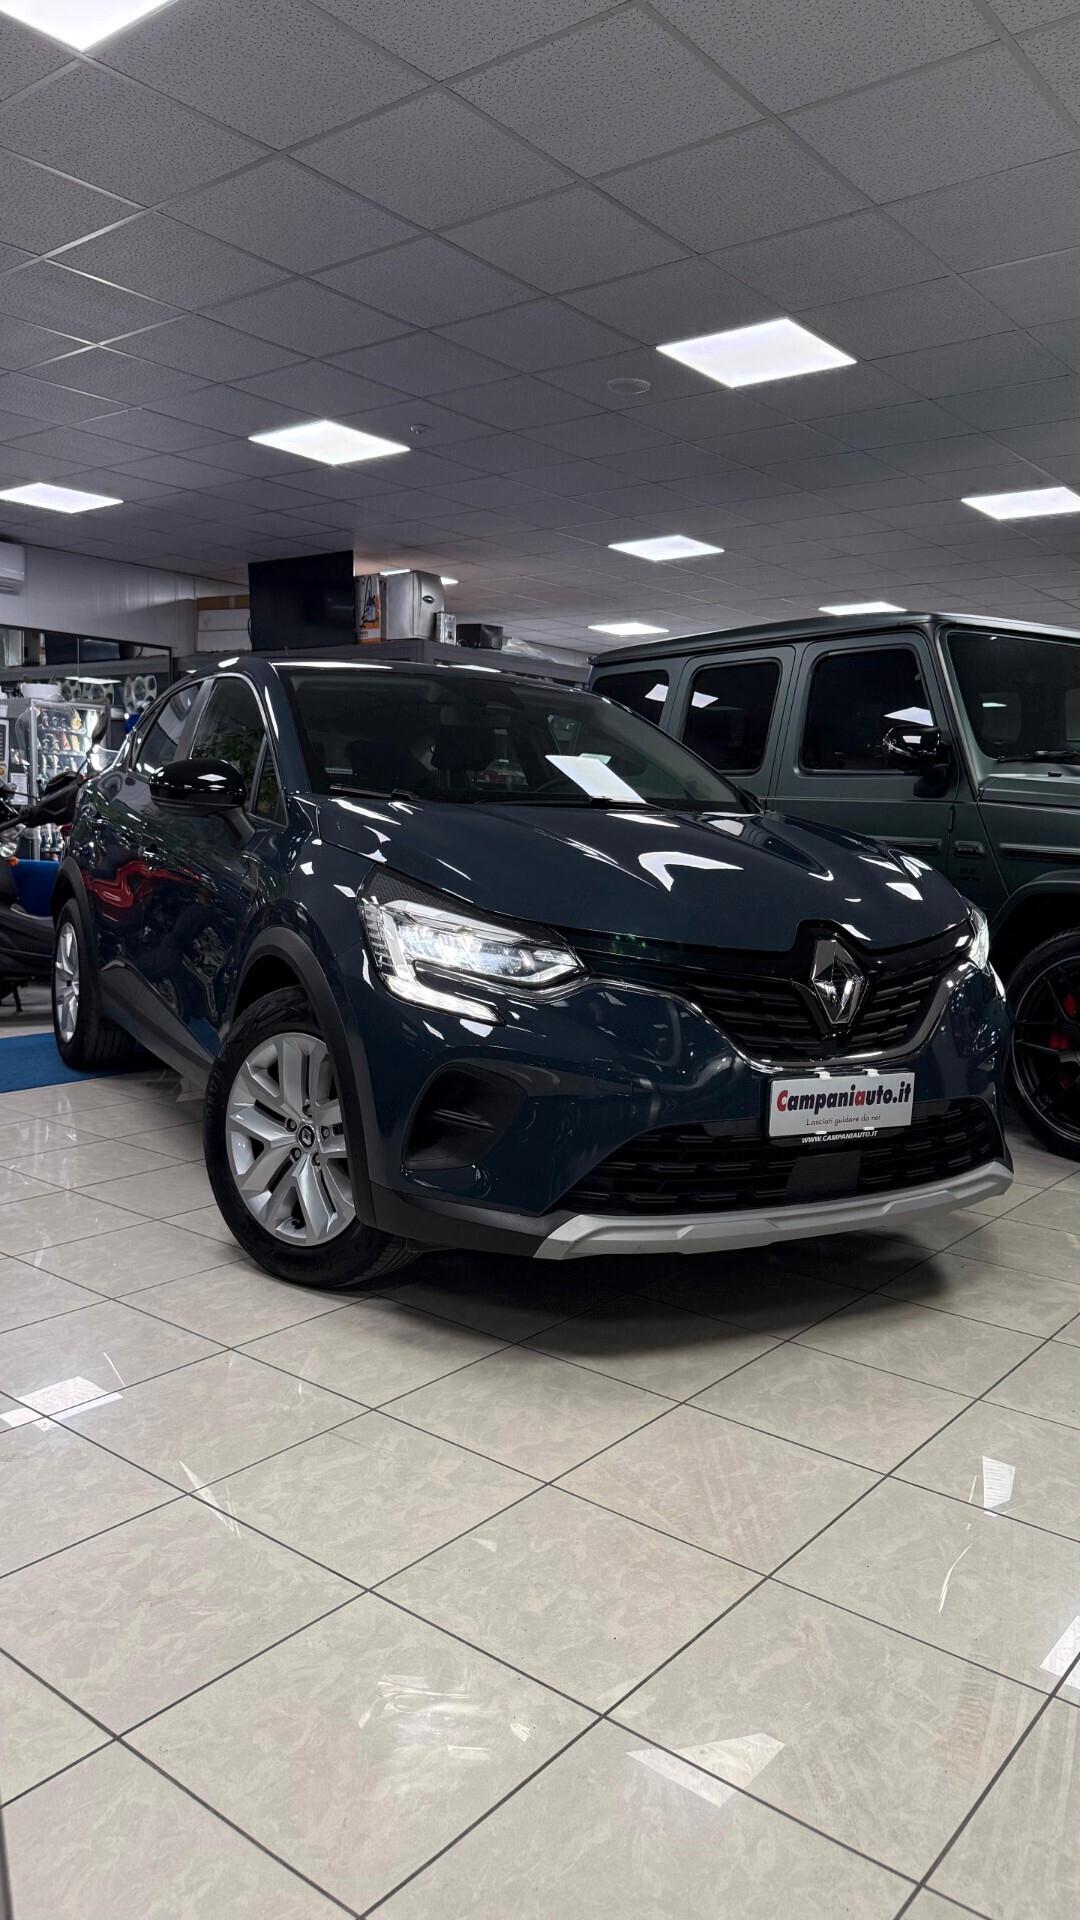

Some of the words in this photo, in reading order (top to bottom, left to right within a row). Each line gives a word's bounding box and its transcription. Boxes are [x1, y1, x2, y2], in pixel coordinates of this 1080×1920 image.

[776, 1081, 911, 1115] Campaniauto.it
[834, 1115, 859, 1126] guidare
[861, 1113, 870, 1122] da
[801, 1130, 878, 1144] WWW.CAMPANIAUTO.IT
